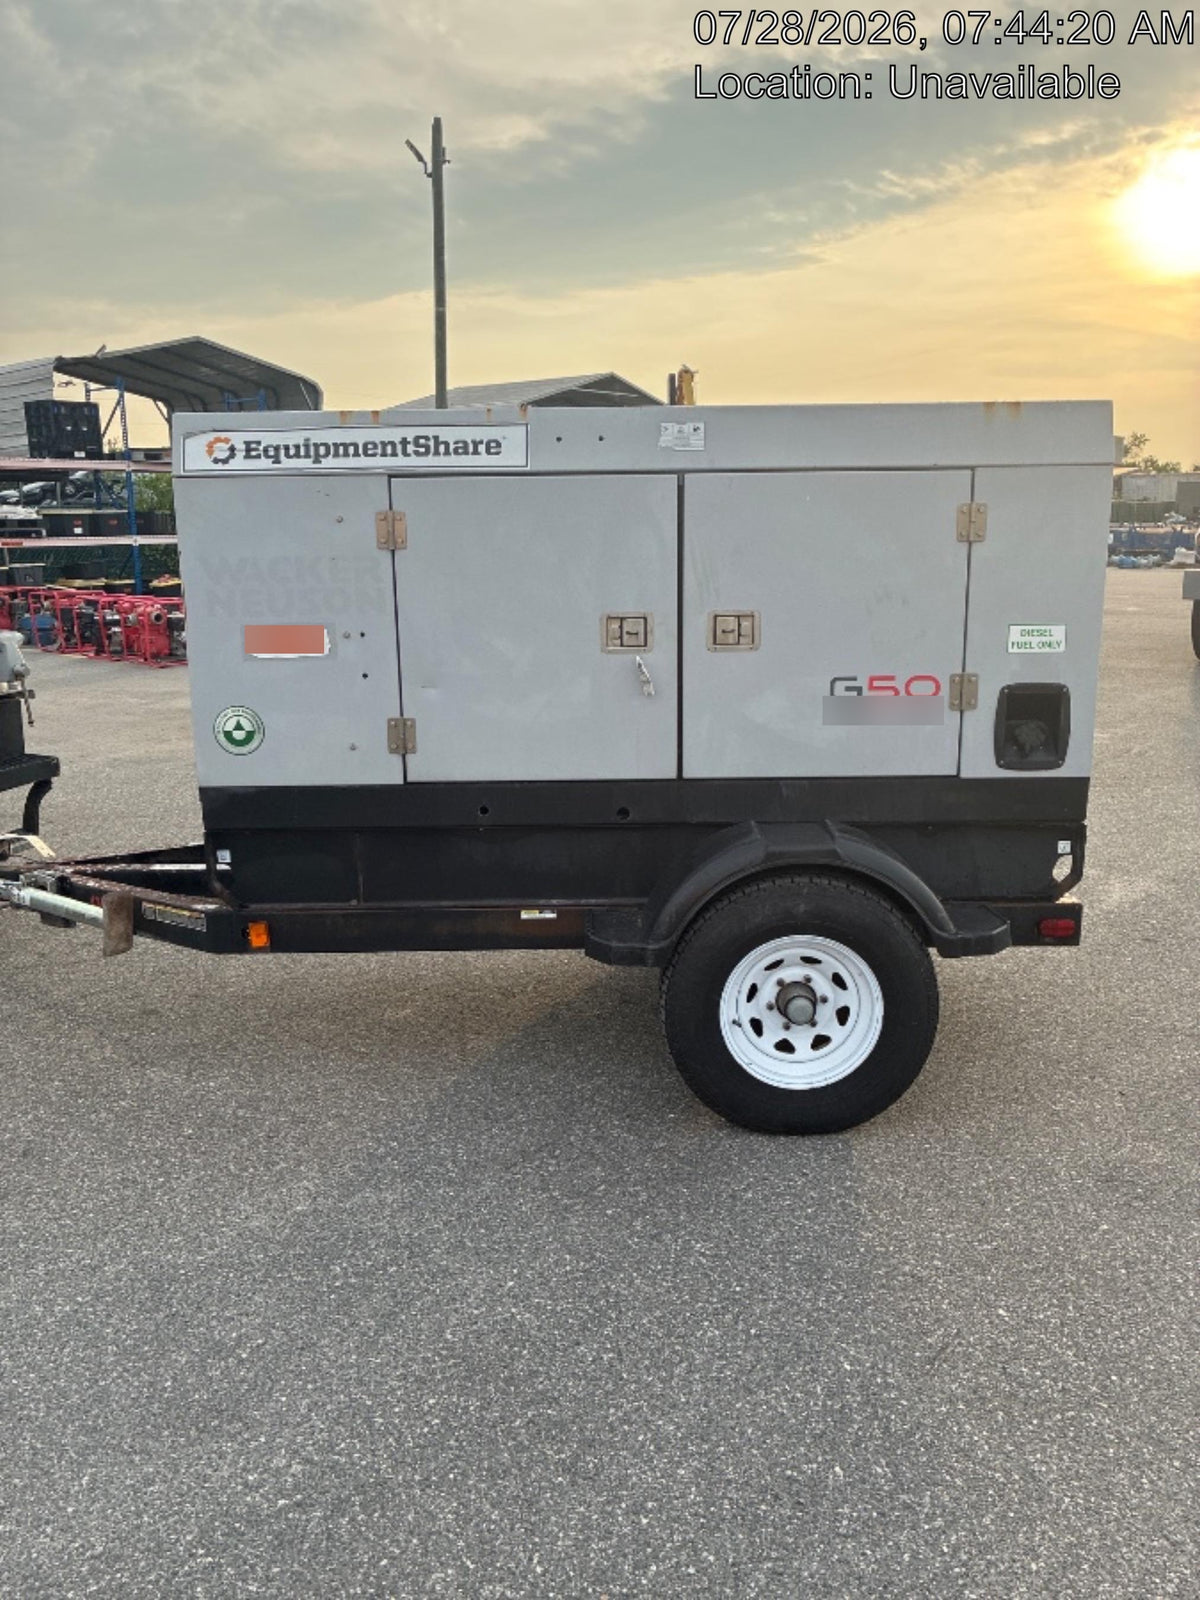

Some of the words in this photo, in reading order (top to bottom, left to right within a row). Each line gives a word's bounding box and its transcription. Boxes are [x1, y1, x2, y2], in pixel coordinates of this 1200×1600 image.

[243, 435, 502, 464] EquipmentShare
[1019, 628, 1053, 637] DIESEL
[1011, 640, 1035, 650] FUEL
[1037, 640, 1062, 650] ONLY
[830, 675, 942, 697] G50
